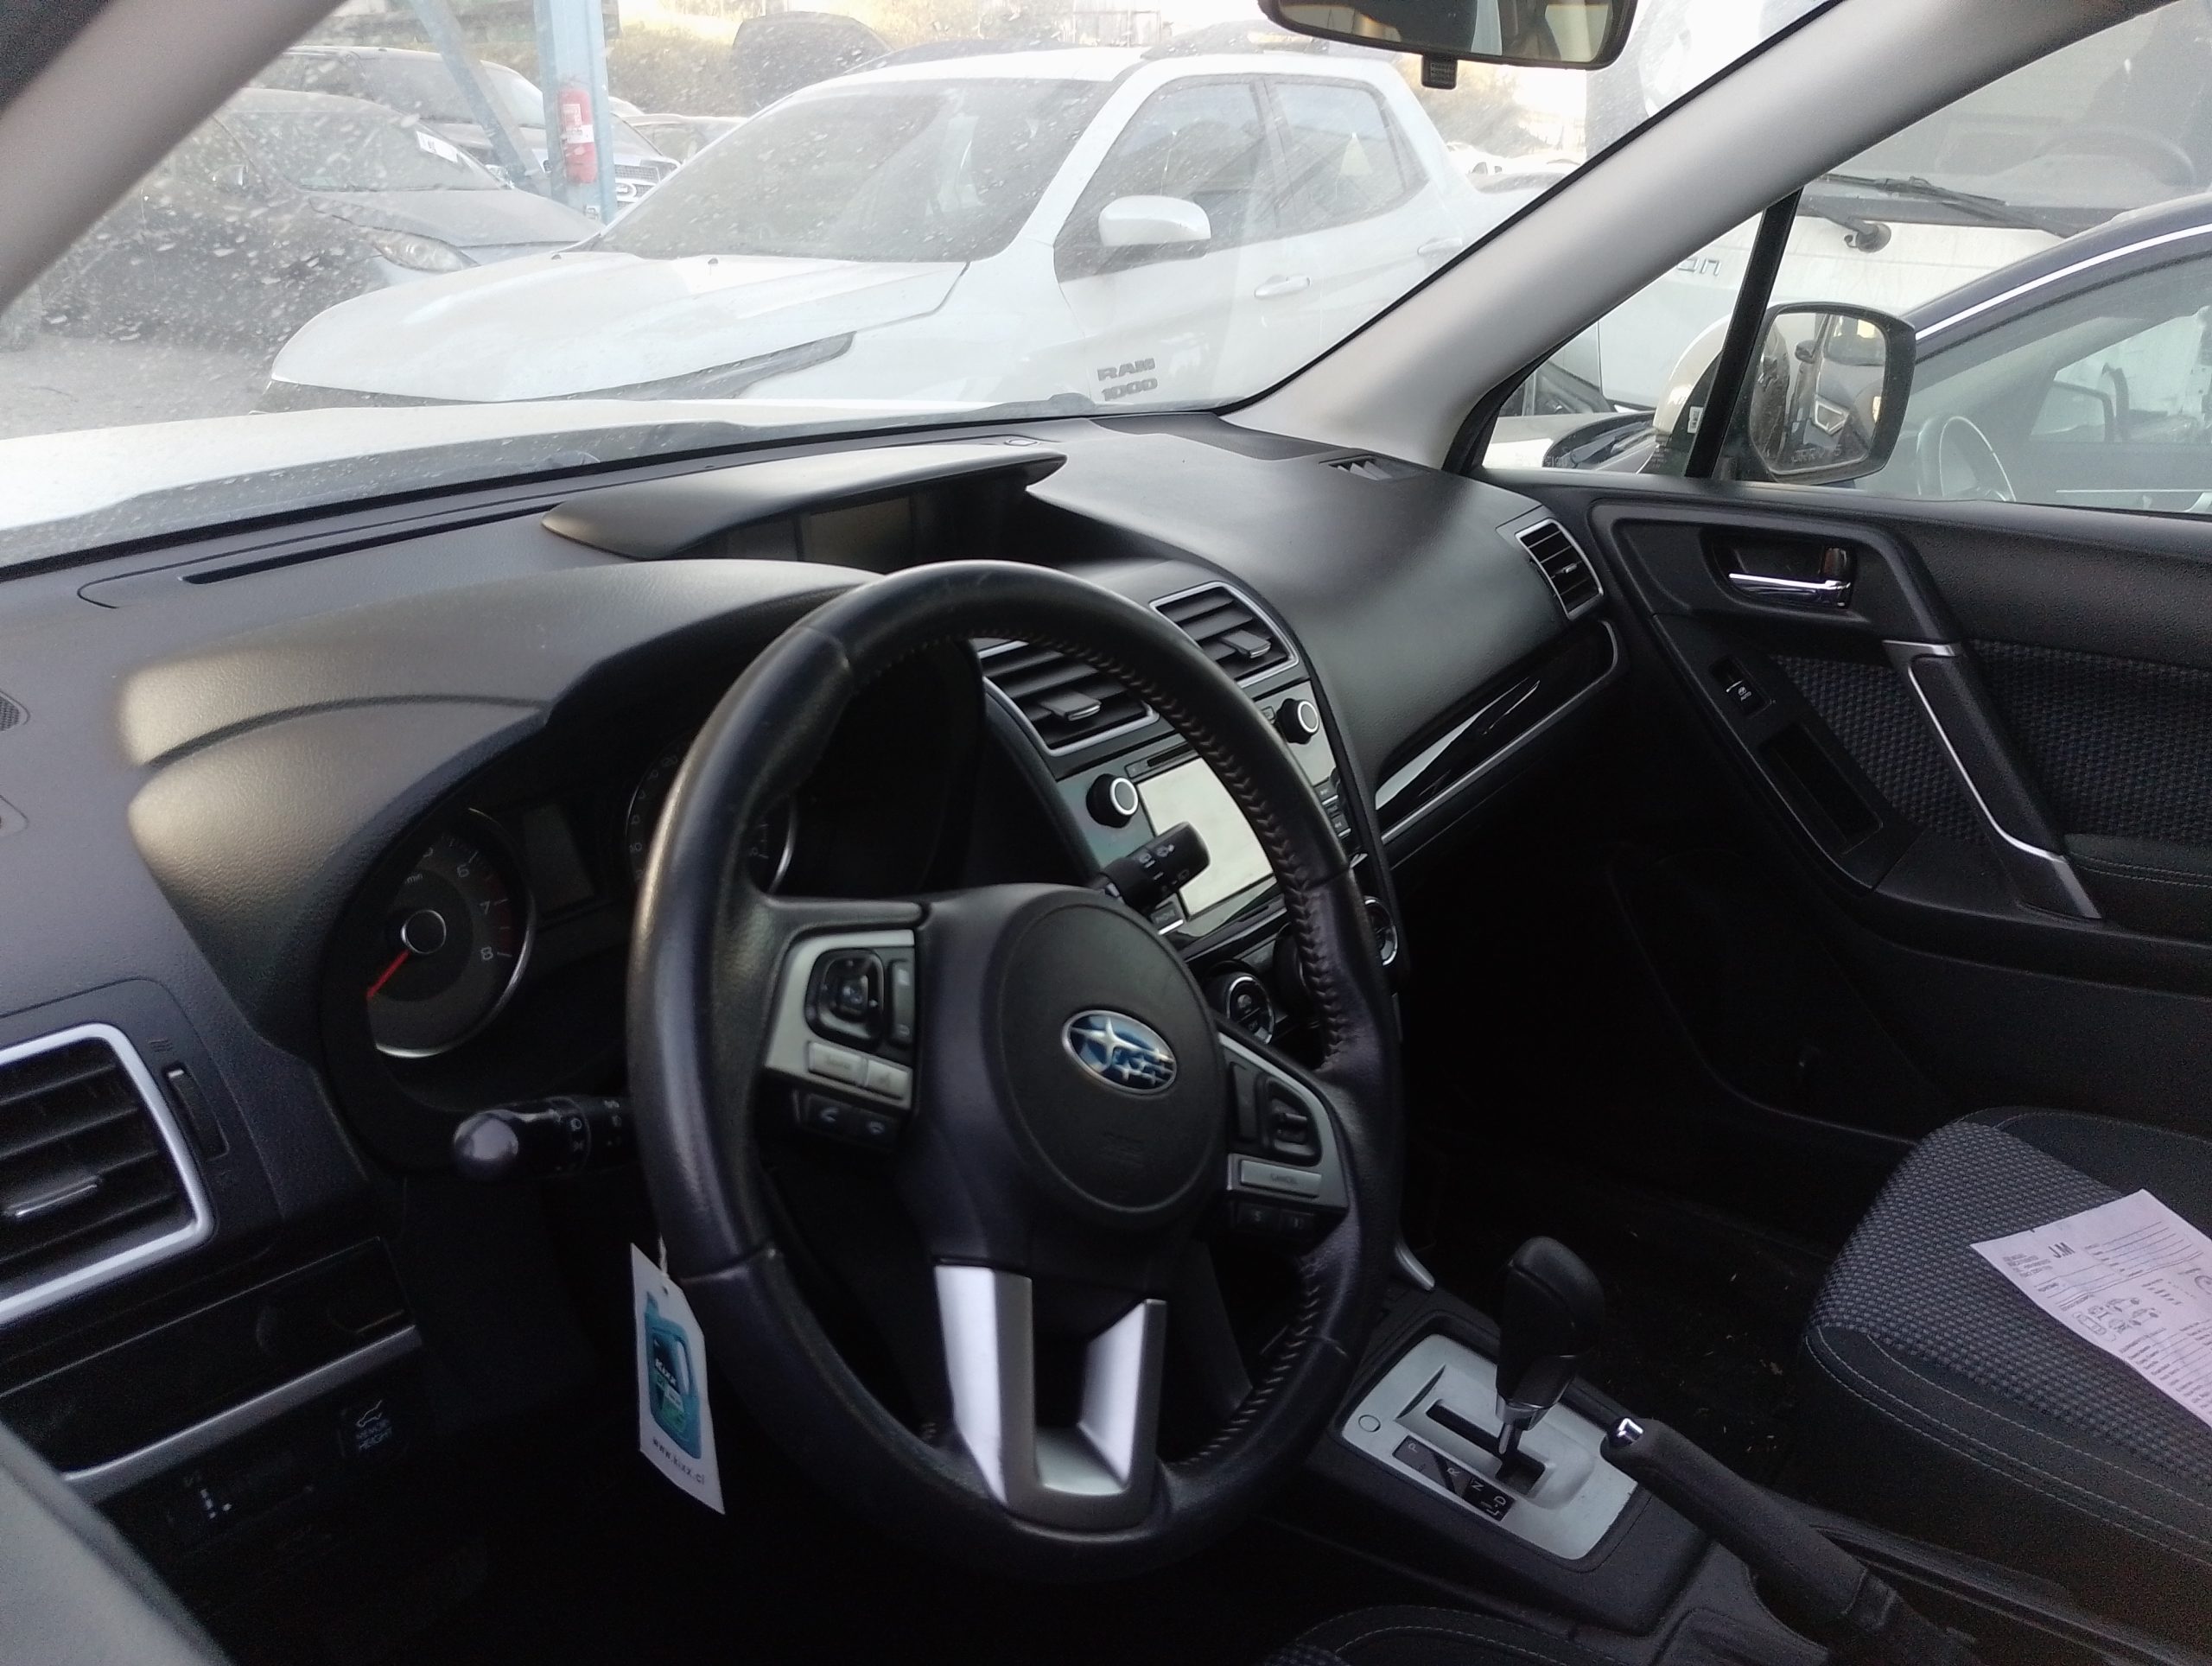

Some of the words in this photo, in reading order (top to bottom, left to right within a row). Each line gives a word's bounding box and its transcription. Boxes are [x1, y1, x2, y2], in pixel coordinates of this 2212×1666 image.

[1096, 357, 1156, 381] RAM
[1101, 378, 1159, 402] 1000
[480, 900, 492, 915] 7
[480, 946, 494, 962] 8
[1408, 1443, 1419, 1453] P
[1446, 1467, 1461, 1477] R
[1471, 1479, 1485, 1492] N
[1493, 1495, 1507, 1506] D
